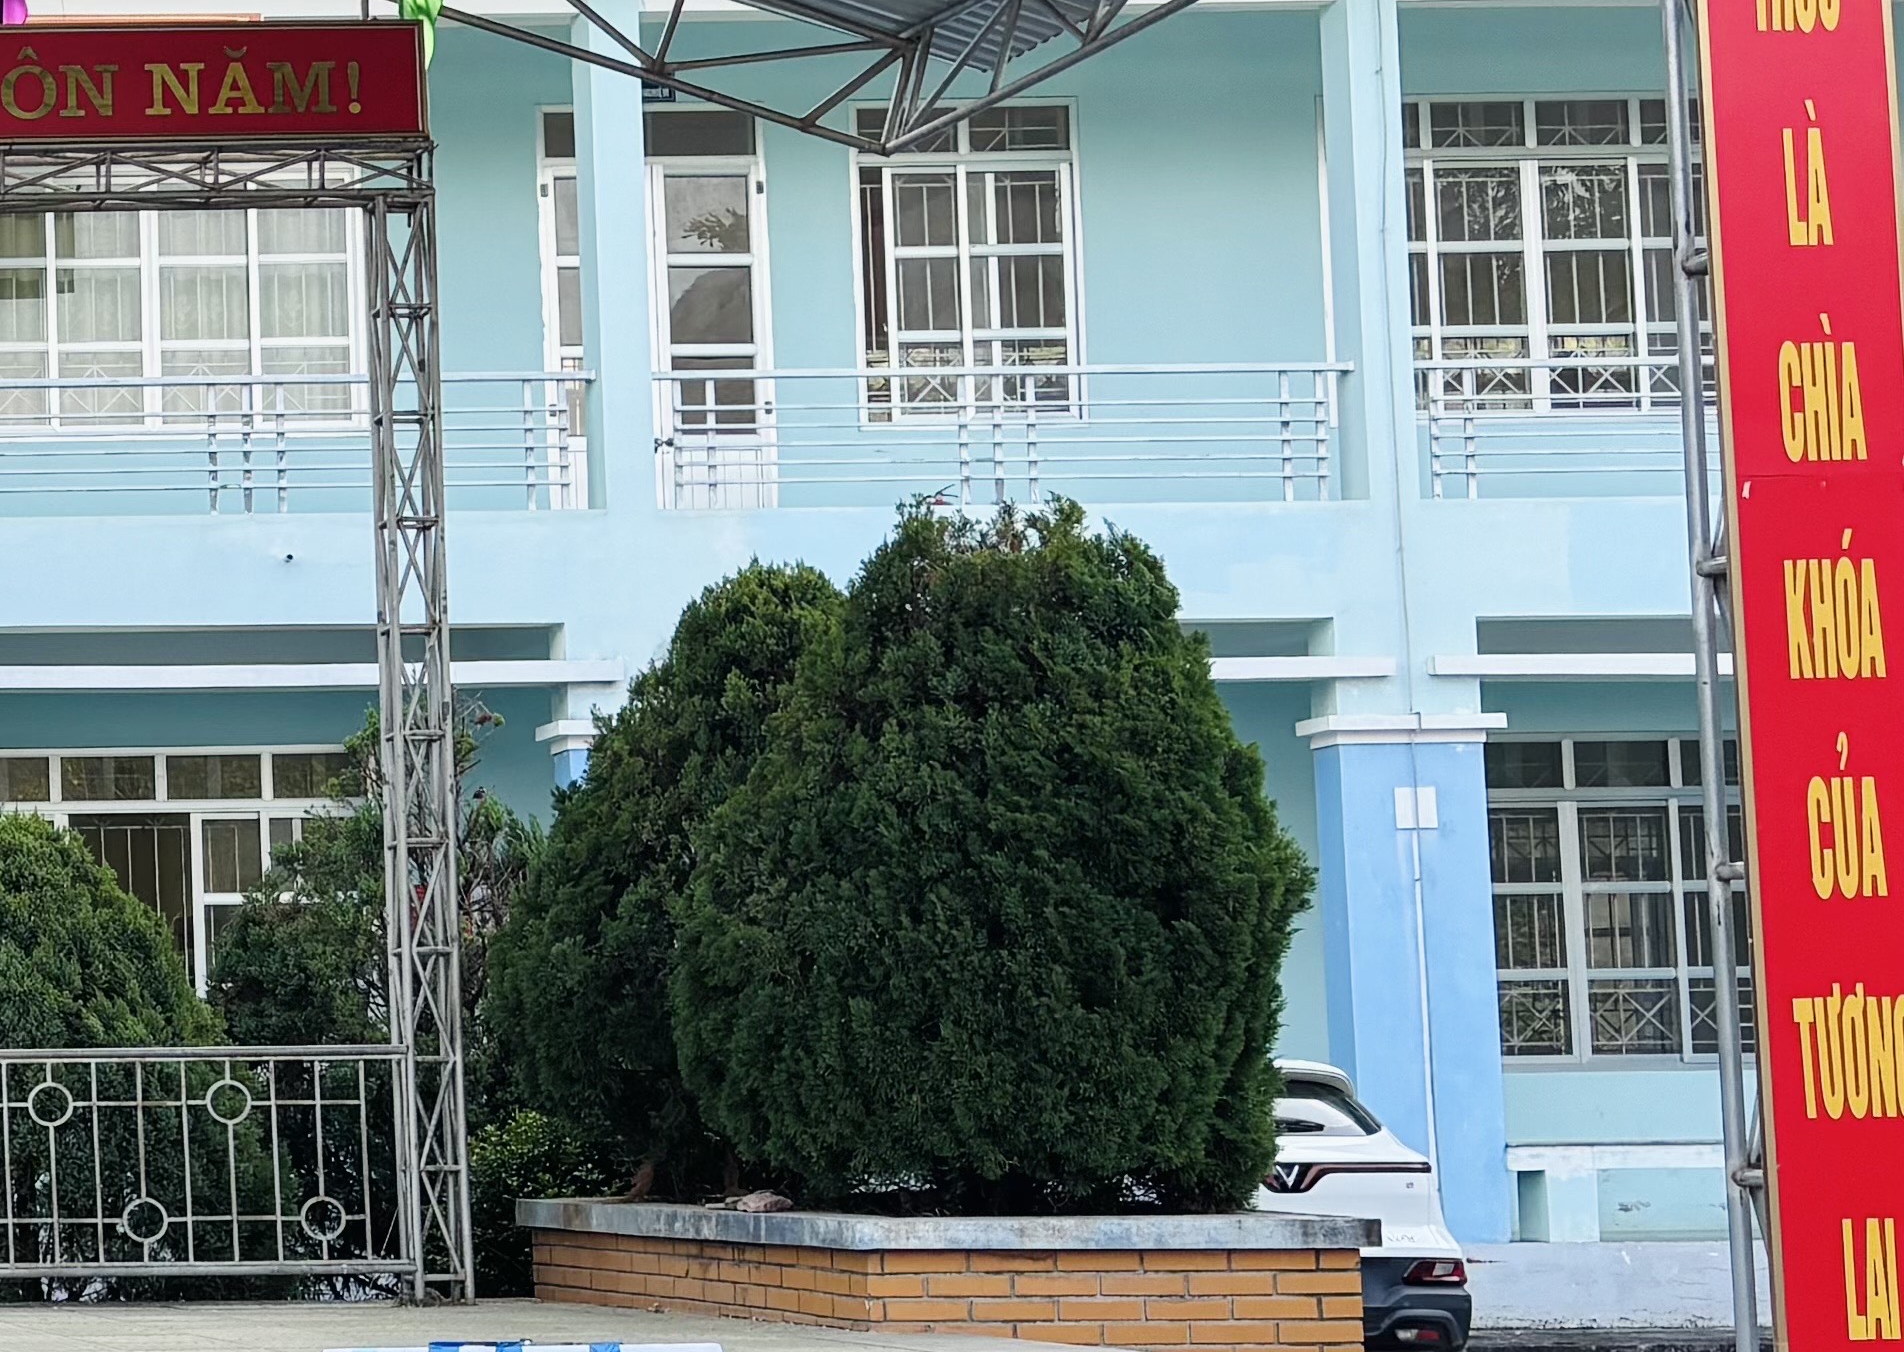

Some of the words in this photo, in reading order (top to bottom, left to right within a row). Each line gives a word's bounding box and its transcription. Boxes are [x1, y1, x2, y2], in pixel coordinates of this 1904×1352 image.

[143, 45, 363, 117] NĂM!
[1782, 99, 1834, 246] LÀ
[1778, 313, 1868, 463] CHÌA
[1783, 529, 1887, 679] KHÓA
[1806, 732, 1889, 900] CỦA
[1842, 1217, 1902, 1341] LAI
